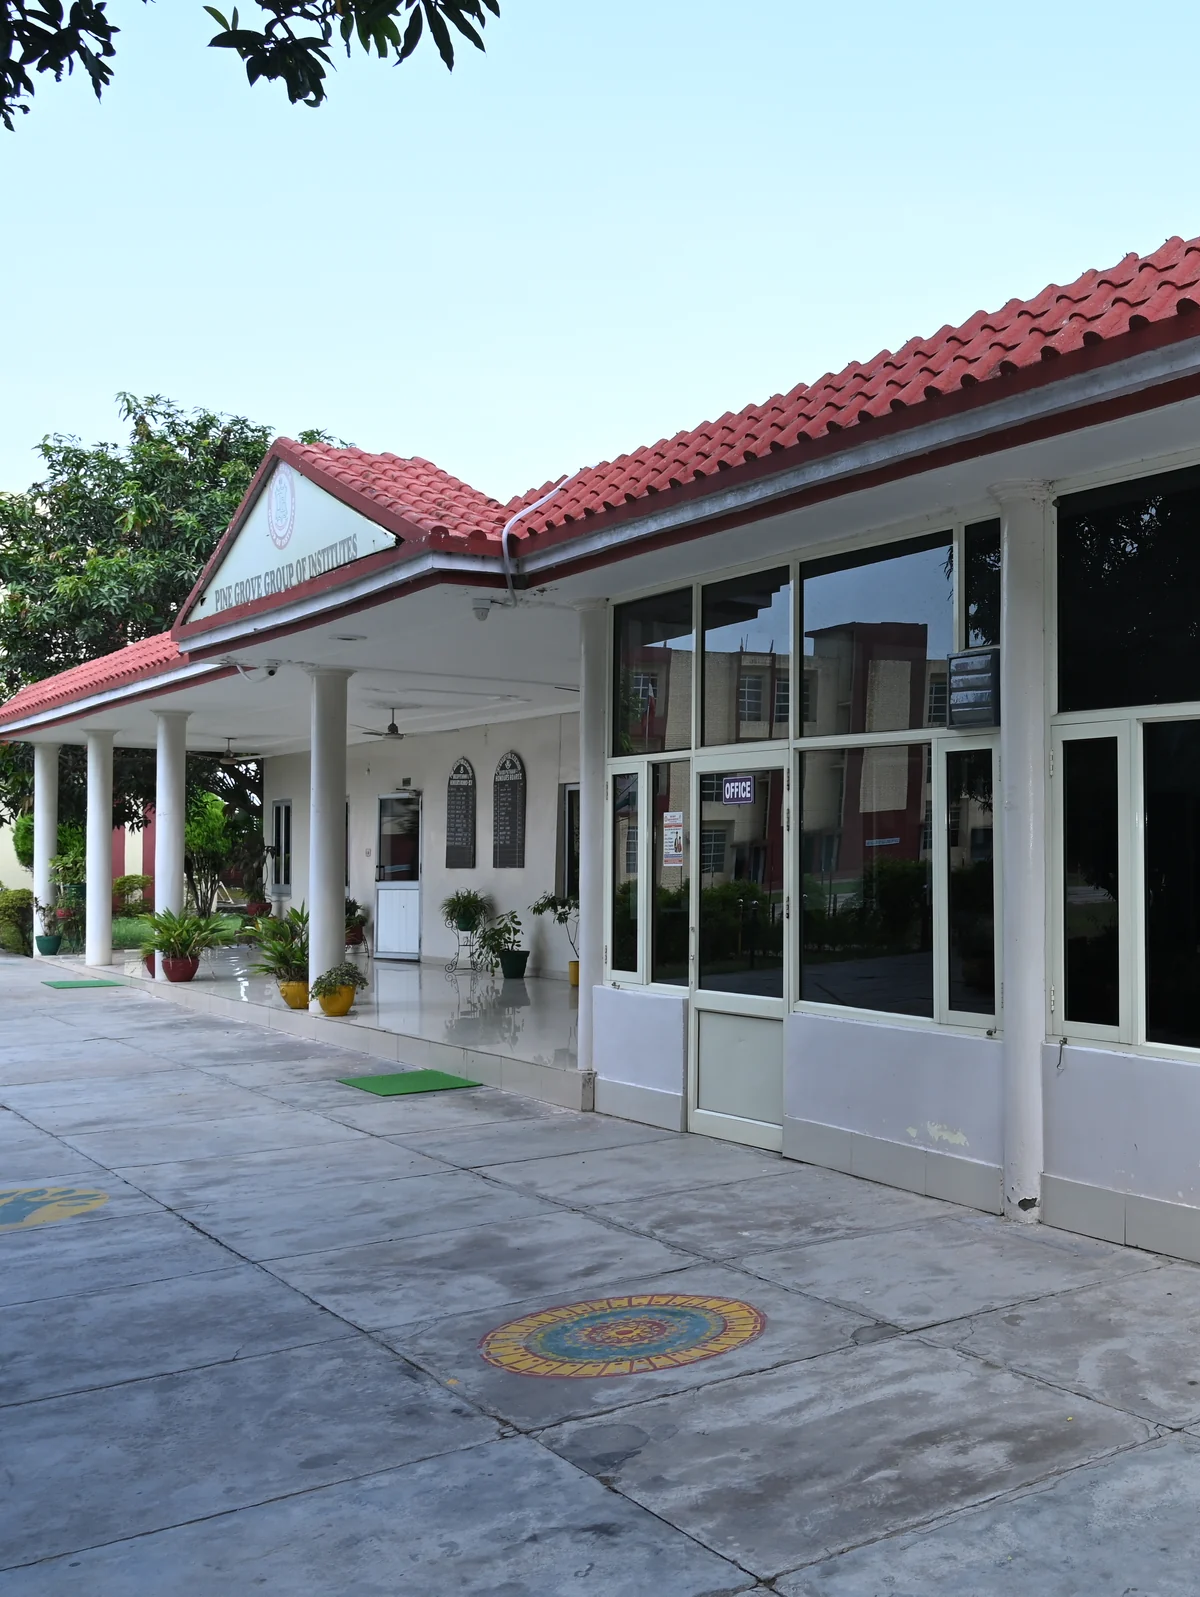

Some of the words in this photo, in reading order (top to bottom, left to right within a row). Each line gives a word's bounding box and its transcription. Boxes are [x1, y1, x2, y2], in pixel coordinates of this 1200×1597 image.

[214, 585, 232, 612] PINE
[234, 574, 262, 606] GROVE
[264, 562, 294, 596] GROUP
[296, 556, 307, 584] OF
[308, 533, 358, 578] INSTITUTES
[724, 781, 751, 799] OFFICE
